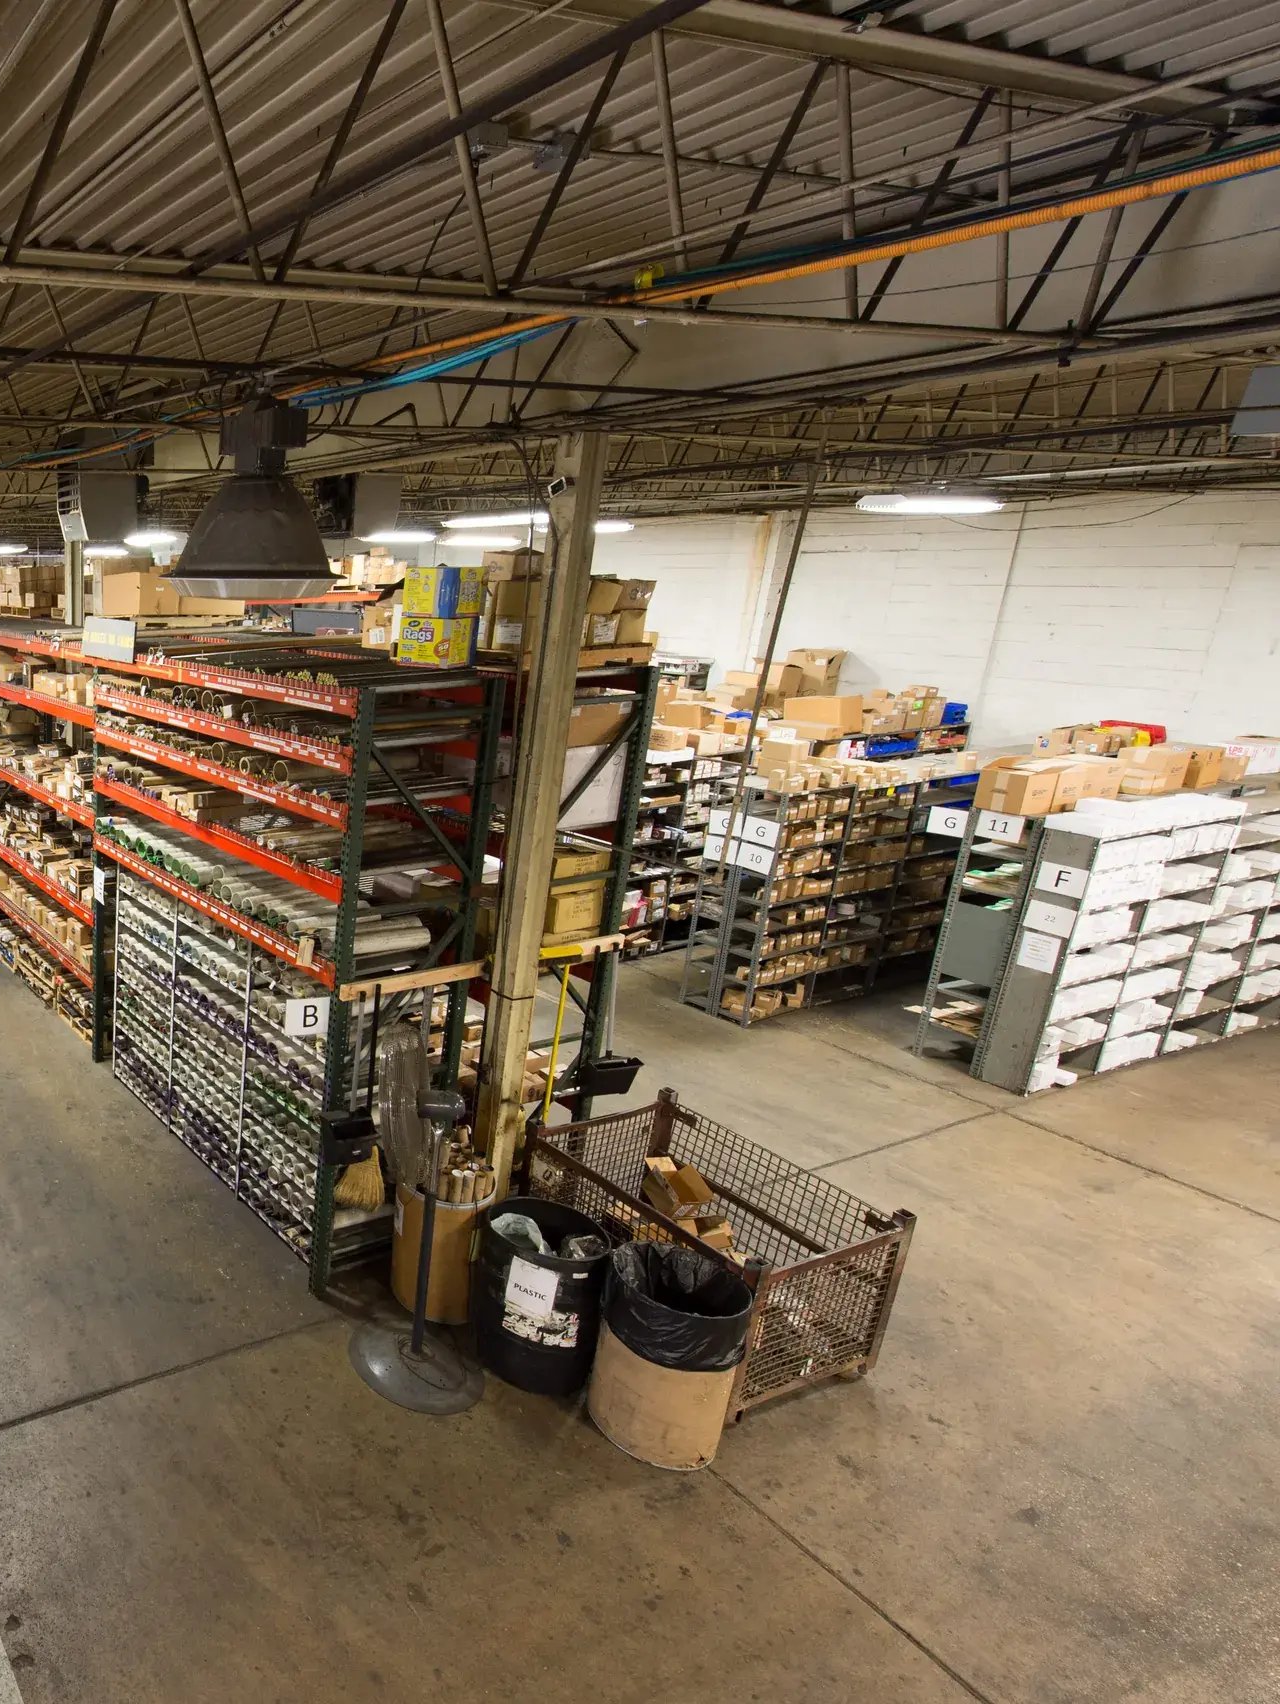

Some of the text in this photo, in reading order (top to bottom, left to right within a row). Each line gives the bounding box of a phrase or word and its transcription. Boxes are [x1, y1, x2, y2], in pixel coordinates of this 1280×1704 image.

[403, 628, 432, 643] Rags
[944, 816, 957, 829] G
[988, 819, 1009, 834] 11
[755, 826, 767, 837] G
[750, 853, 763, 864] 10
[1053, 870, 1071, 887] F
[1044, 914, 1056, 923] 22
[303, 1004, 319, 1027] B
[514, 1282, 547, 1301] PLASTIC
